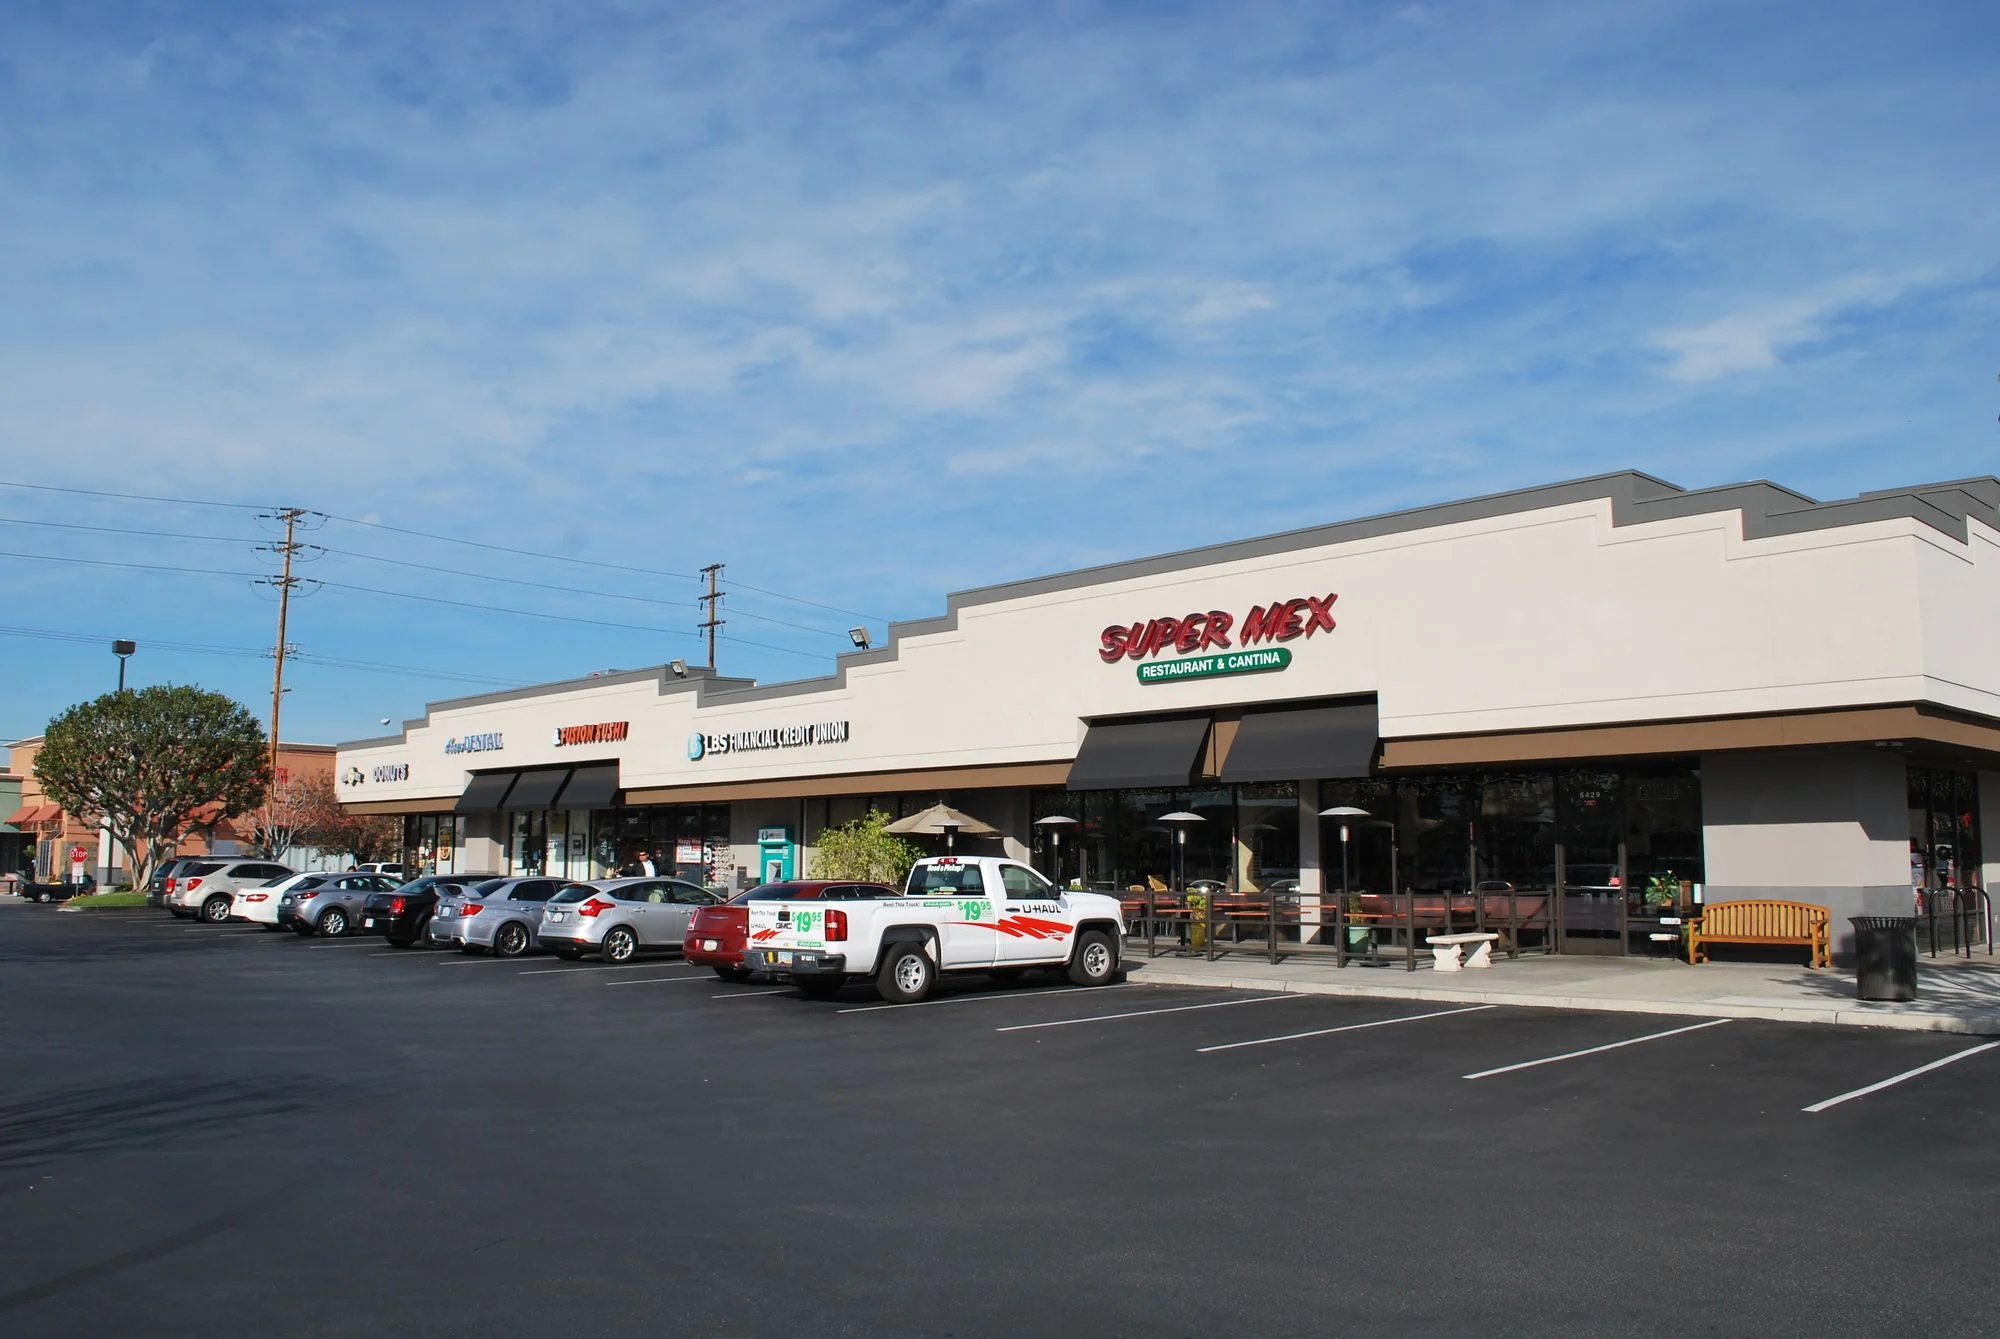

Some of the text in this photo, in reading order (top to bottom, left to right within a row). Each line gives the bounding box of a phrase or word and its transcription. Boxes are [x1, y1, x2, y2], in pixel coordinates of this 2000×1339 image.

[1099, 592, 1338, 664] SUPER MEX
[1142, 651, 1281, 678] RESTAURANT & CANTINA
[464, 732, 503, 752] DENTAL
[560, 721, 629, 746] FUSION SUSHI
[705, 720, 849, 754] LBS FINANCIAL CREDIT UNION
[373, 763, 409, 782] DONUTS
